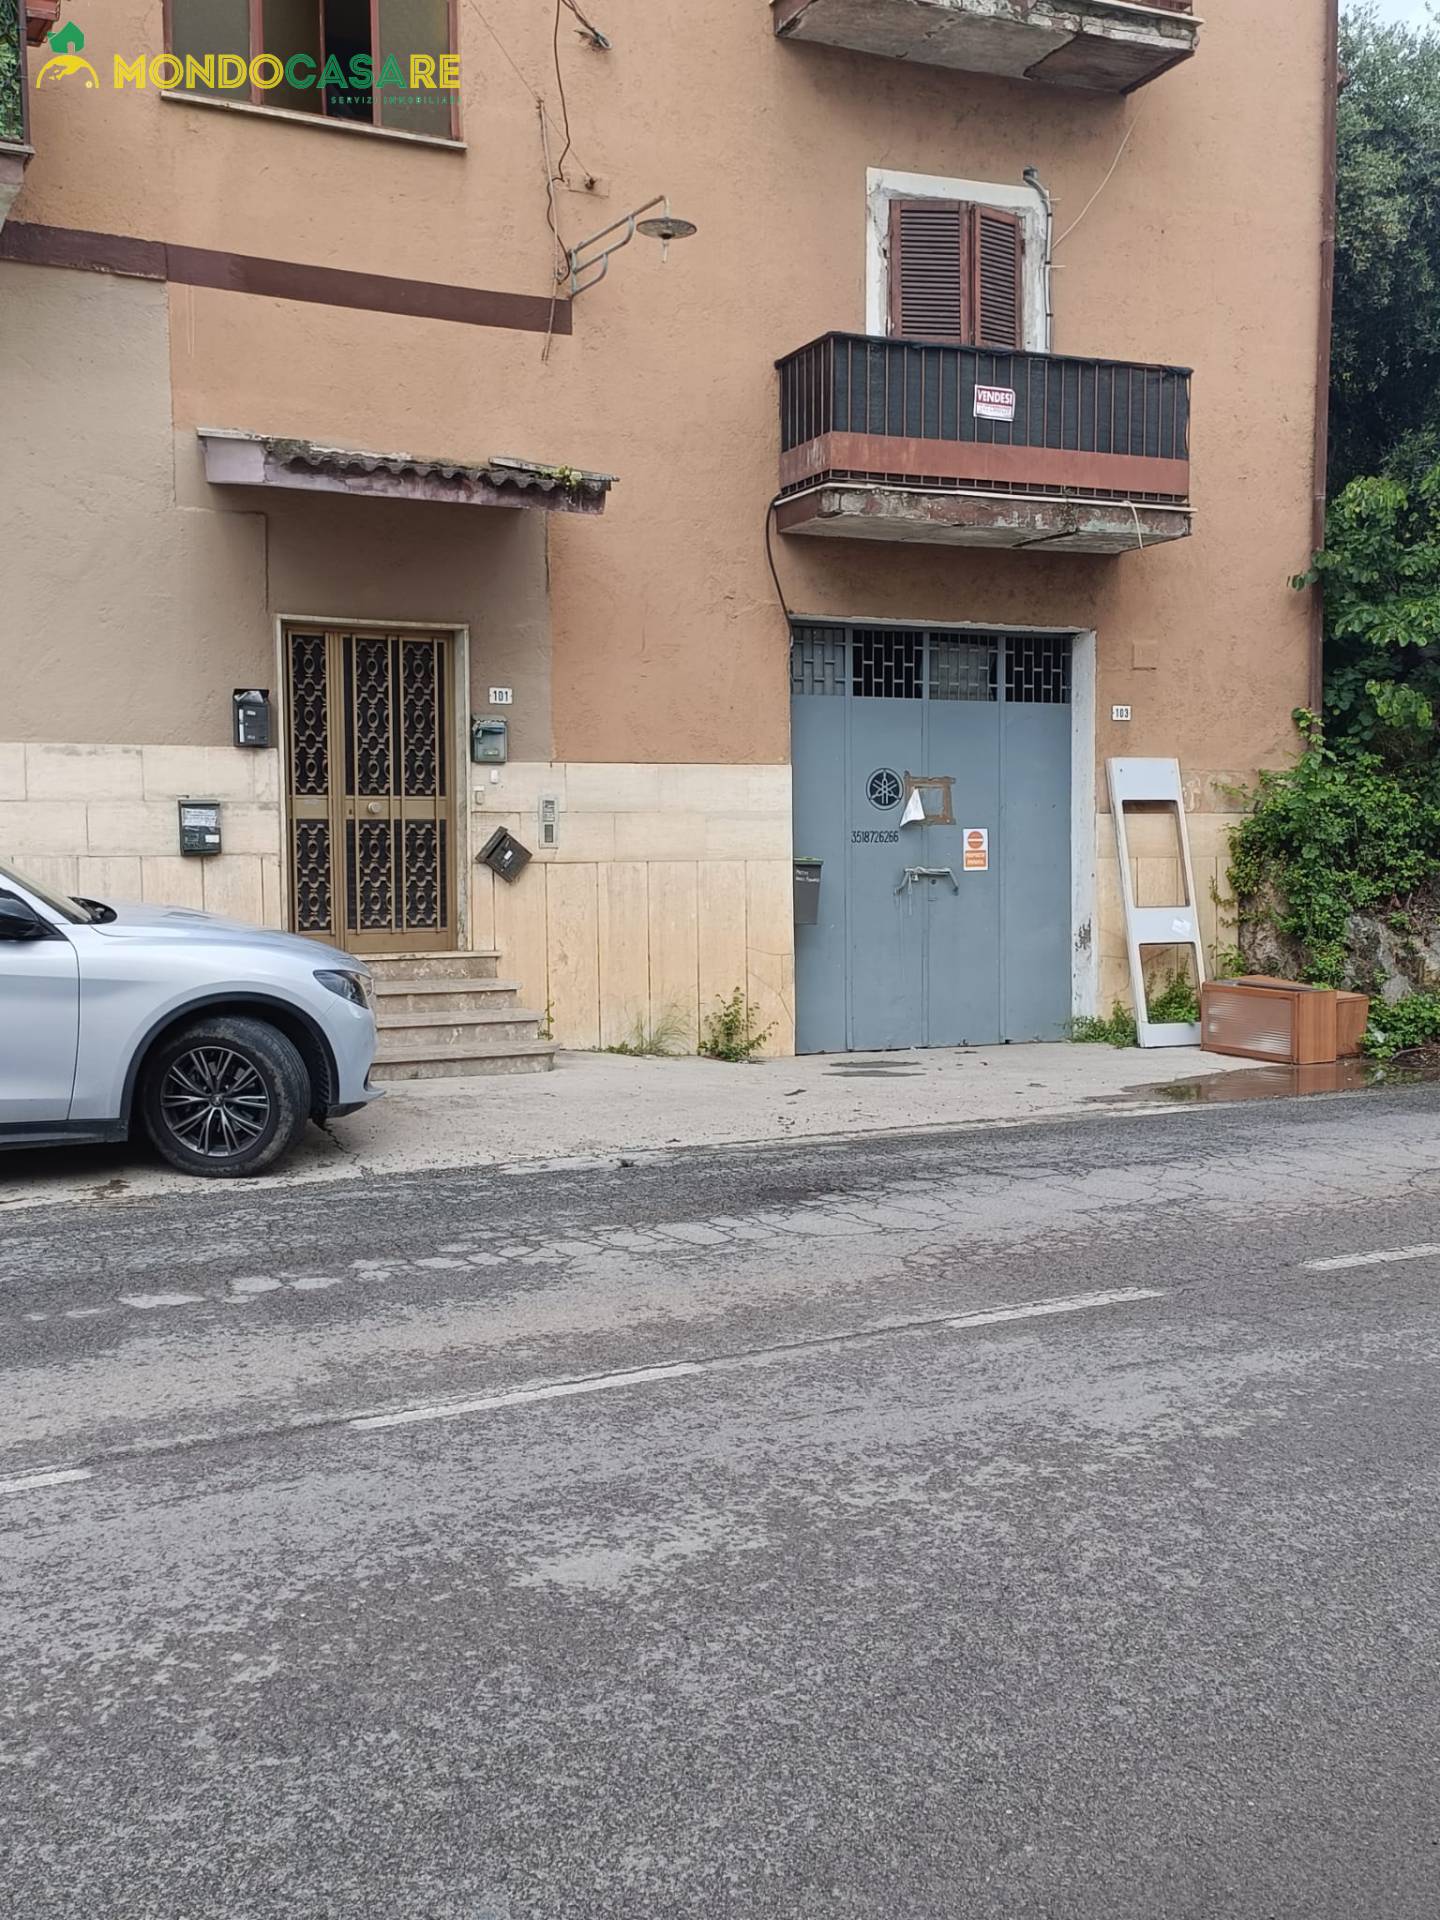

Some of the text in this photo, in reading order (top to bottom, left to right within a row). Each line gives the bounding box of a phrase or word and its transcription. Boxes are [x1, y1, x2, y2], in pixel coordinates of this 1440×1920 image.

[977, 389, 1013, 404] VENDESI
[493, 690, 508, 702] 101
[1115, 707, 1129, 718] 103
